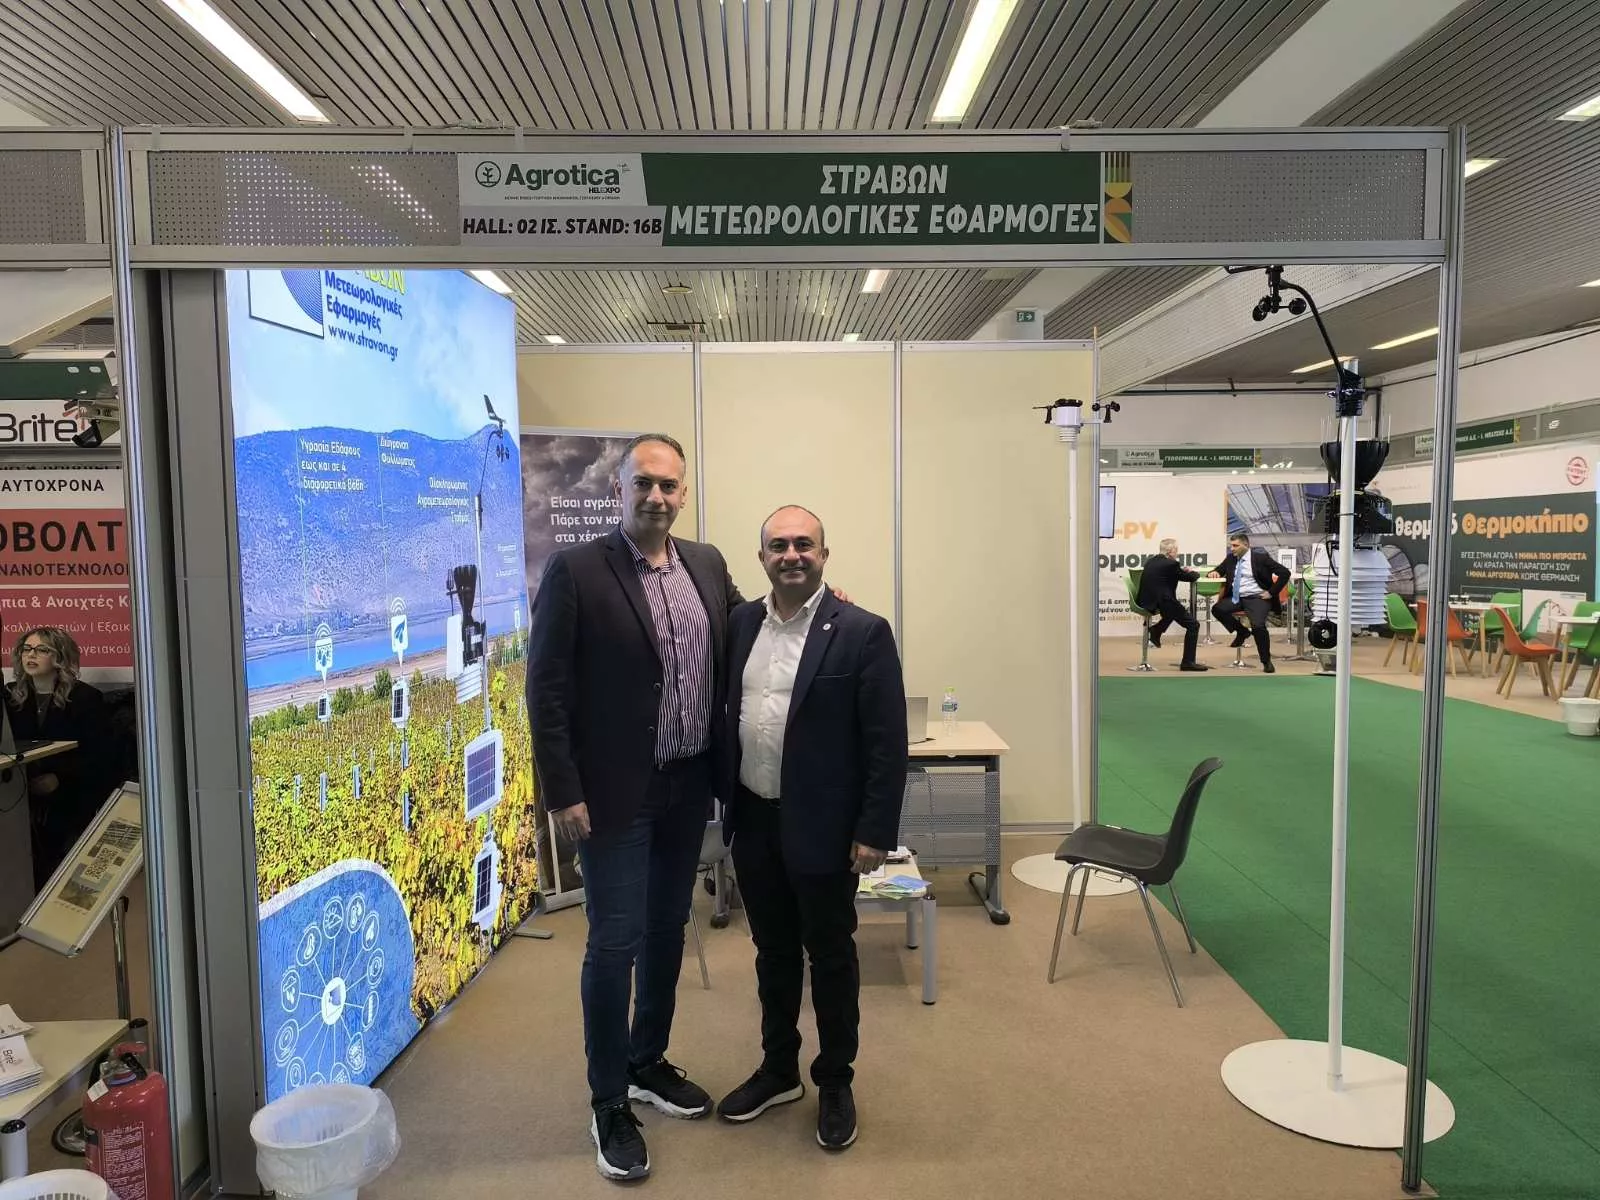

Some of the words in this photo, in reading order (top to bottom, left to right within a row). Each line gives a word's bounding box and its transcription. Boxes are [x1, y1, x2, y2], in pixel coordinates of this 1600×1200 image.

[505, 163, 620, 191] Agrotica
[820, 164, 948, 194] ΣΤΡΑΒΩΝ
[463, 218, 513, 234] HALL:
[517, 218, 537, 234] 02
[565, 218, 630, 234] STAND:
[670, 204, 921, 235] ΜΕΤΕΩΡΟΛΟΓΙΚΕΣ
[929, 203, 1099, 234] ΕΦΑΡΜΟΓΕΣ
[325, 270, 403, 320] Μετεωρολογικές
[326, 294, 382, 334] Εφαρμογές
[328, 324, 399, 362] www.stravon.gr
[2, 479, 104, 491] ΑΥΤΟΧΡΟΝΑ
[550, 496, 580, 508] Είσαι
[550, 513, 581, 528] Πάρε
[583, 517, 602, 525] τον
[1461, 507, 1589, 538] Θερμοκήπιο
[0, 521, 123, 553] ΒΟΛΤ
[555, 533, 576, 543] στα
[31, 596, 42, 608] &
[46, 595, 115, 611] Ανοιχτές
